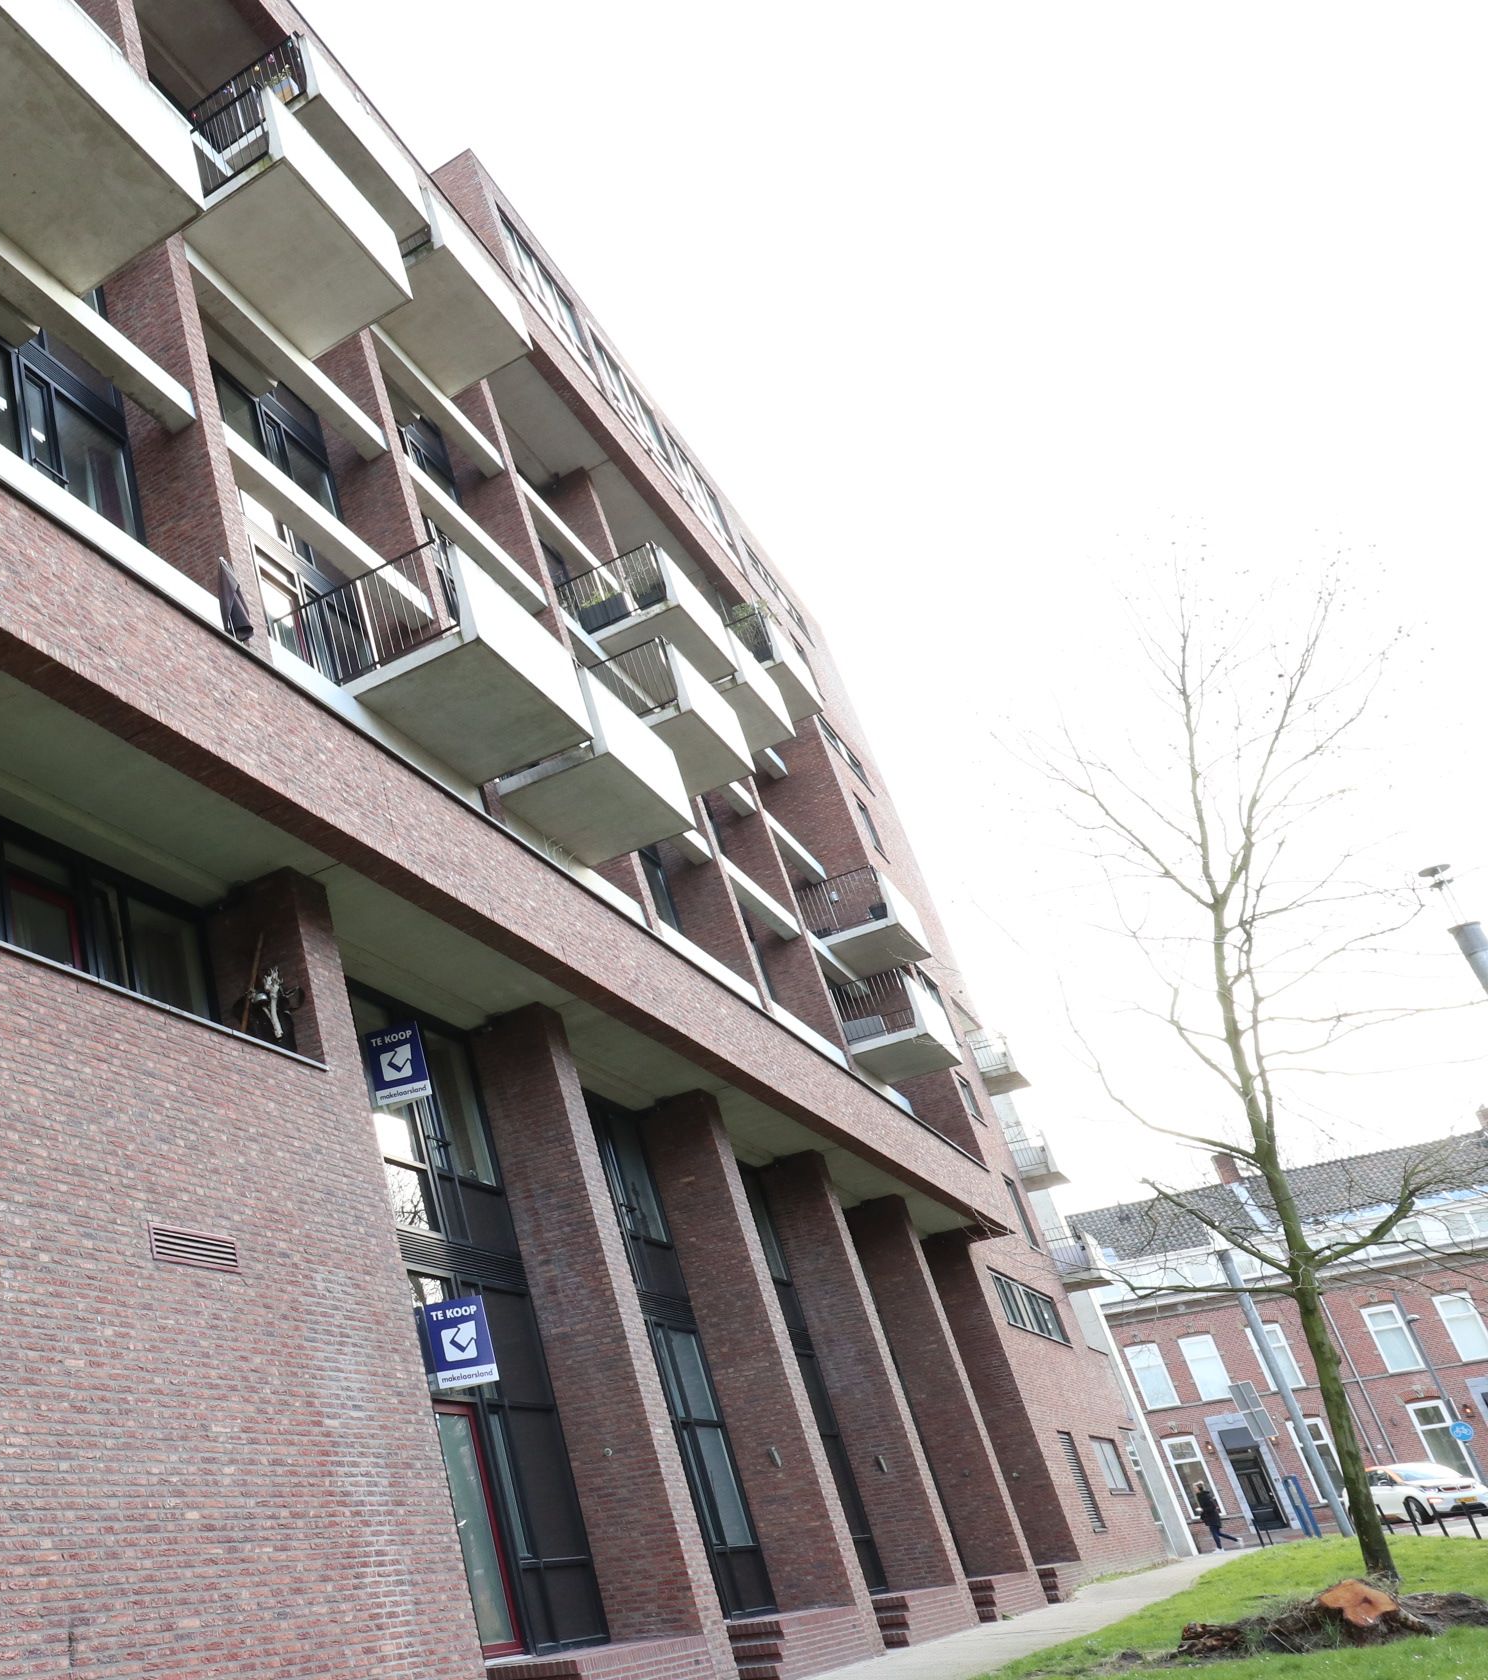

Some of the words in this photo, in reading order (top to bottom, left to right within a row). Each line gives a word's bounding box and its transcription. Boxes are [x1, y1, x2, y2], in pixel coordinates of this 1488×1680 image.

[371, 1037, 383, 1047] TE
[384, 1030, 412, 1044] KOOP
[379, 1084, 426, 1100] makelaarsland
[430, 1310, 444, 1321] TE
[446, 1305, 477, 1319] KOOP
[441, 1368, 493, 1383] makelaarsland
